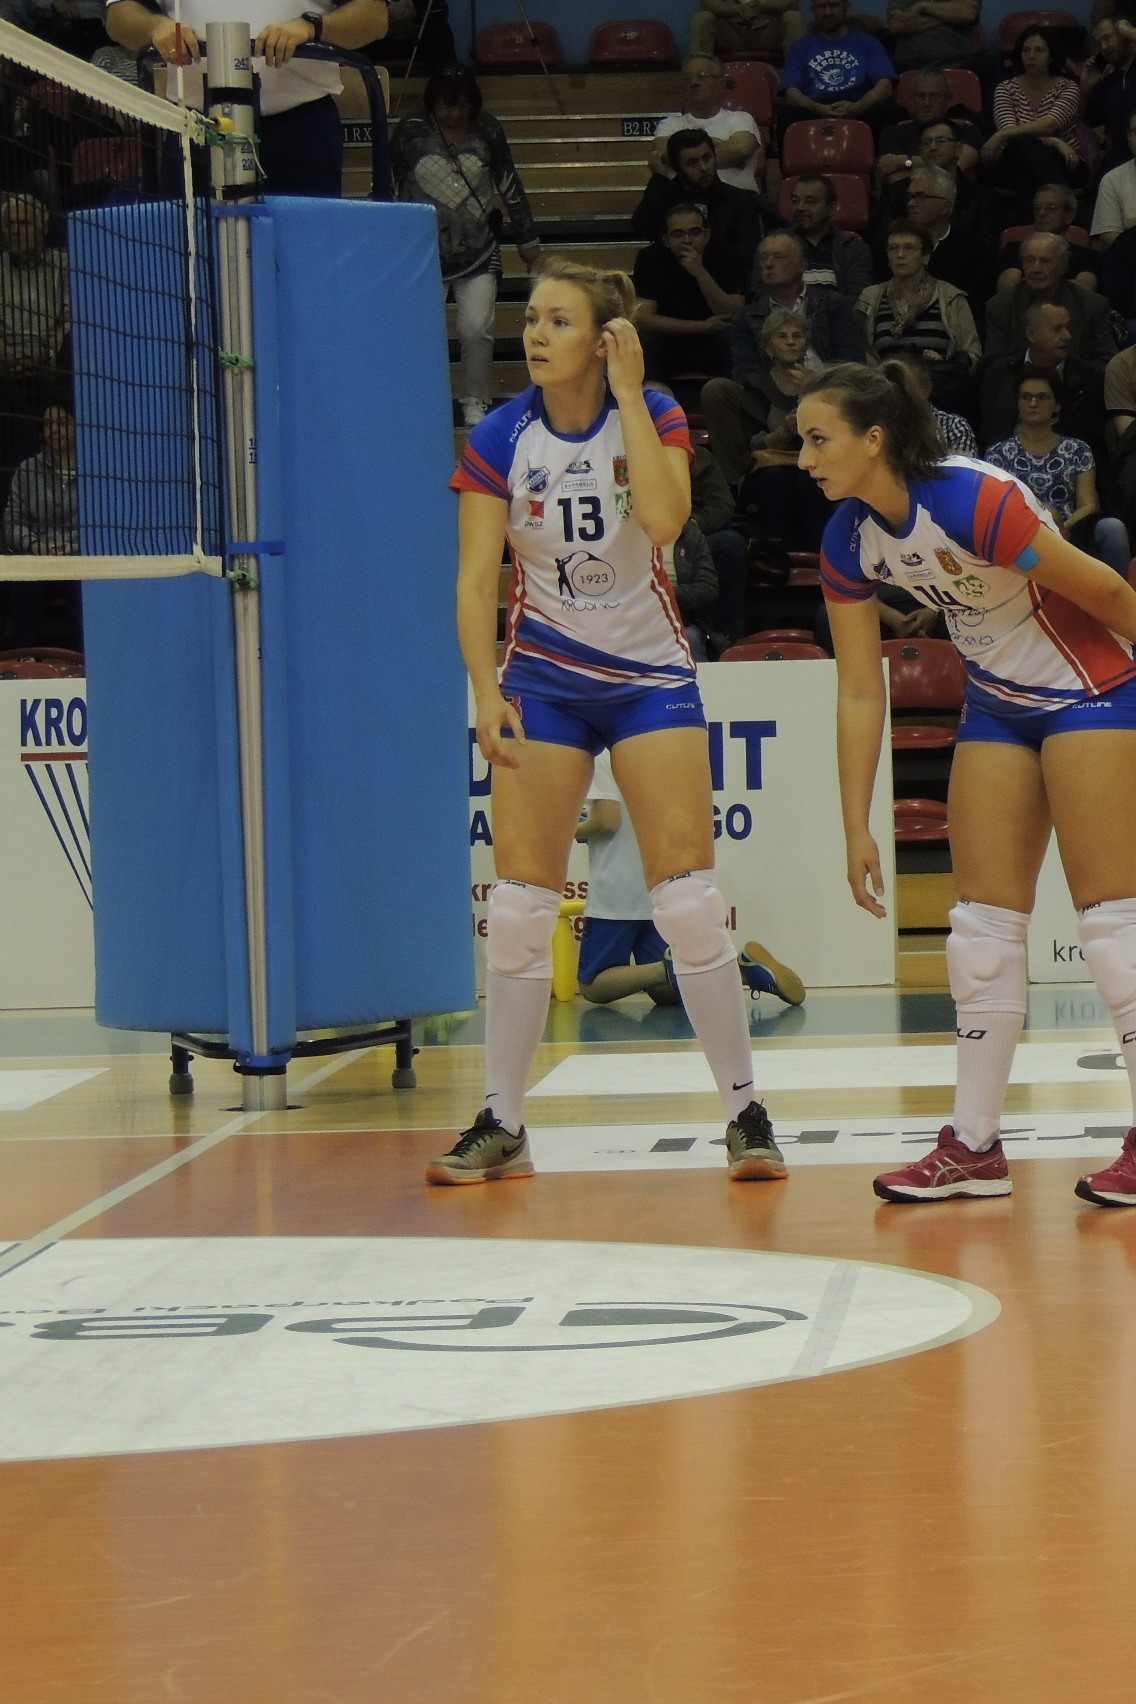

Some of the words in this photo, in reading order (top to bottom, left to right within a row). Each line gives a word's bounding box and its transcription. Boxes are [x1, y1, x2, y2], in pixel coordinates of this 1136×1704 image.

[808, 50, 859, 69] KARPATY
[557, 495, 606, 543] 13
[578, 572, 610, 585] 1923
[20, 697, 88, 748] KRO
[957, 1027, 988, 1041] LO
